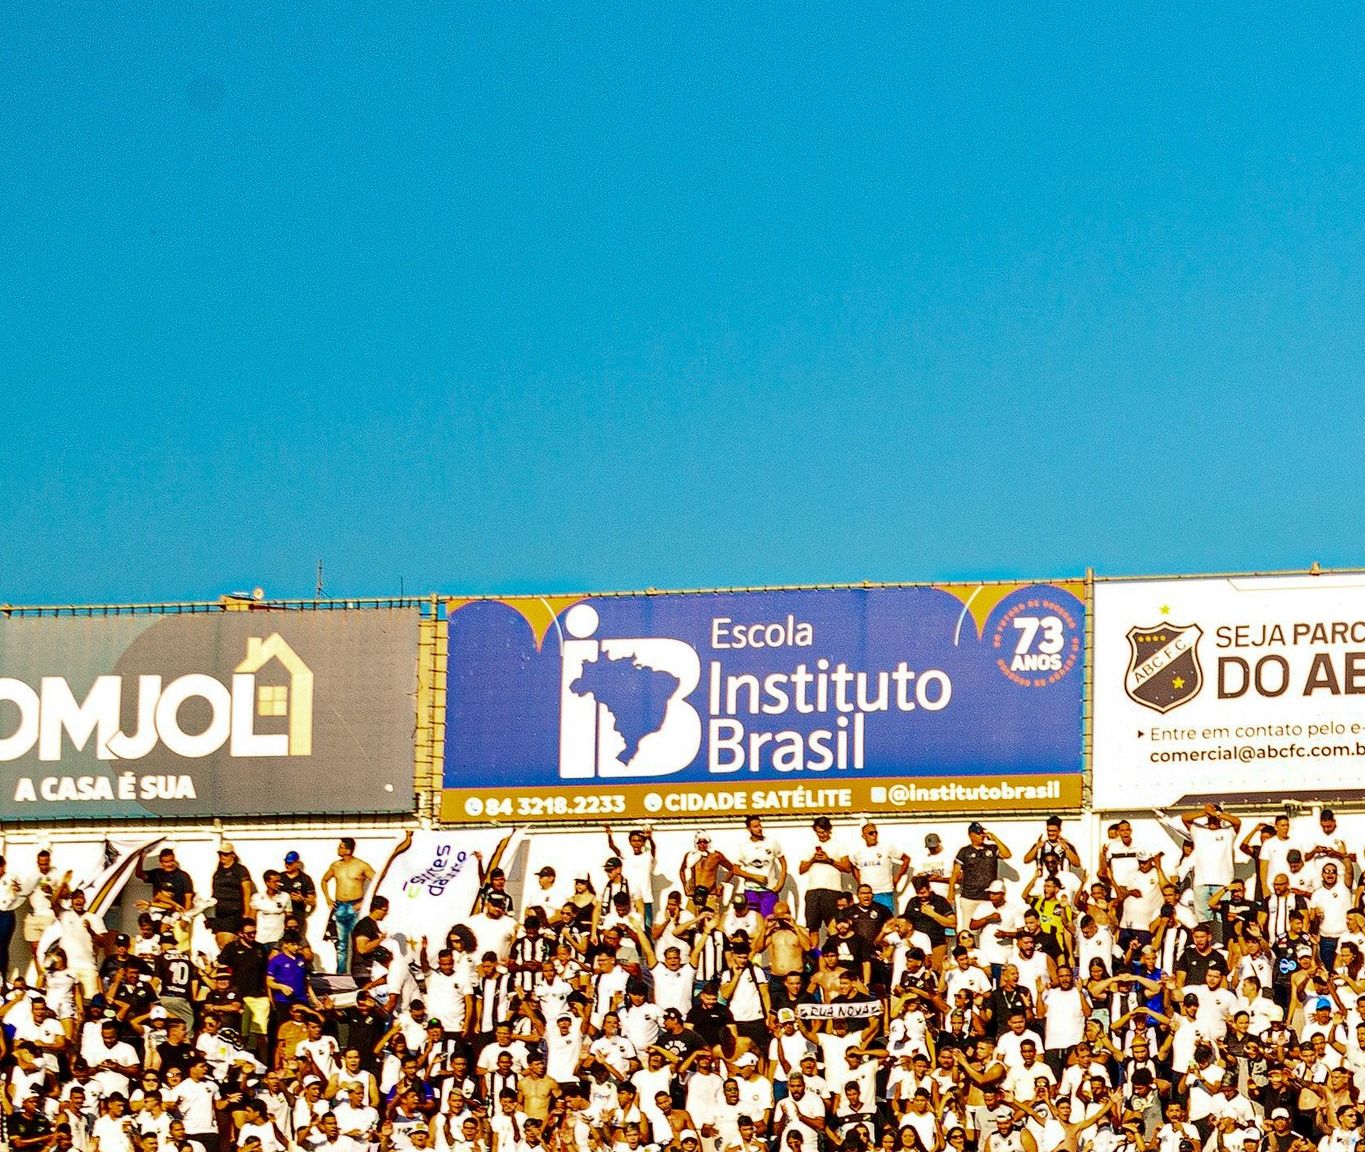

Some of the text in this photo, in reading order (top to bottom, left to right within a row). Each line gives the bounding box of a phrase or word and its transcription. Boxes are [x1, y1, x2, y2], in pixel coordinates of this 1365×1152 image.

[712, 615, 812, 648] Escola
[1013, 616, 1064, 654] 73
[1215, 624, 1286, 648] SEJA
[1010, 654, 1062, 671] ANOS
[1133, 659, 1164, 684] ABC
[710, 659, 952, 715] Instituto
[1217, 654, 1290, 700] DO
[708, 713, 865, 773] Brasil
[1150, 727, 1196, 741] Entre
[1201, 728, 1229, 739] em
[1235, 724, 1302, 738] contato
[1307, 720, 1345, 739] pelo
[14, 772, 197, 801] A CASA É SUA
[665, 786, 851, 812] CIDADE SATÉLITE
[888, 781, 1060, 805] @institutobrasil
[486, 795, 626, 815] 84 3218.2233
[169, 961, 190, 985] 10
[809, 1006, 870, 1017] RUA NOVA
